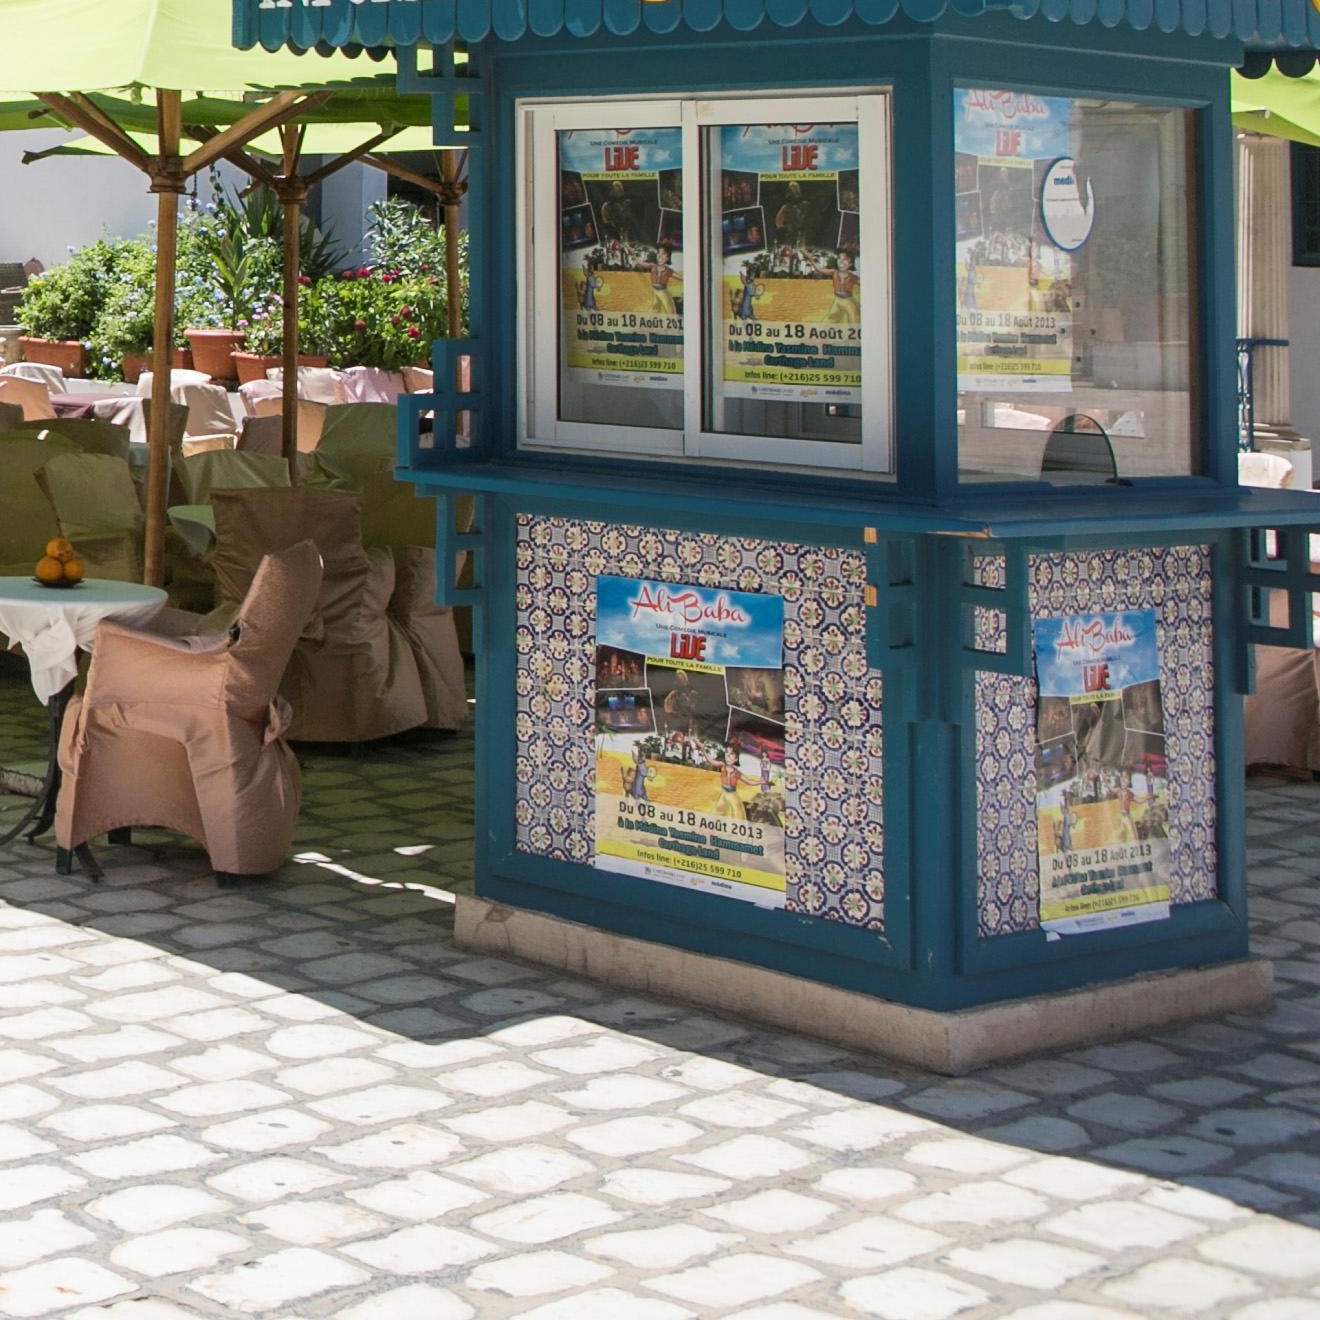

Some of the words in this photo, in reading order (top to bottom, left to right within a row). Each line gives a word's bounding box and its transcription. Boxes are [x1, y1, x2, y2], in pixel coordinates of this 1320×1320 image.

[576, 314, 588, 326] Du
[589, 313, 604, 326] 08
[607, 317, 619, 327] au
[621, 314, 637, 328] 18
[639, 316, 664, 329] Août
[666, 318, 684, 330] 201
[729, 324, 742, 336] Du
[745, 322, 762, 337] 08
[766, 327, 780, 337] au
[784, 323, 805, 338] 18
[809, 327, 843, 340] Août
[847, 328, 862, 340] 20
[969, 312, 983, 326] 08
[998, 312, 1011, 327] 18
[1034, 316, 1056, 329] 2013
[823, 374, 841, 383] 599
[631, 585, 672, 619] Ali
[669, 592, 745, 626] Baba
[618, 801, 634, 815] Du
[637, 803, 656, 819] 08
[659, 810, 674, 822] au
[677, 810, 696, 826] 18
[699, 817, 728, 833] Août
[731, 823, 763, 840] 2013
[636, 849, 656, 861] Infos
[656, 854, 672, 864] line:
[709, 864, 725, 875] 599
[726, 868, 742, 879] 710
[1052, 858, 1063, 871] Du
[1065, 853, 1079, 869] 08
[1081, 855, 1092, 866] au
[1094, 849, 1108, 864] 18
[1130, 843, 1152, 859] 2013
